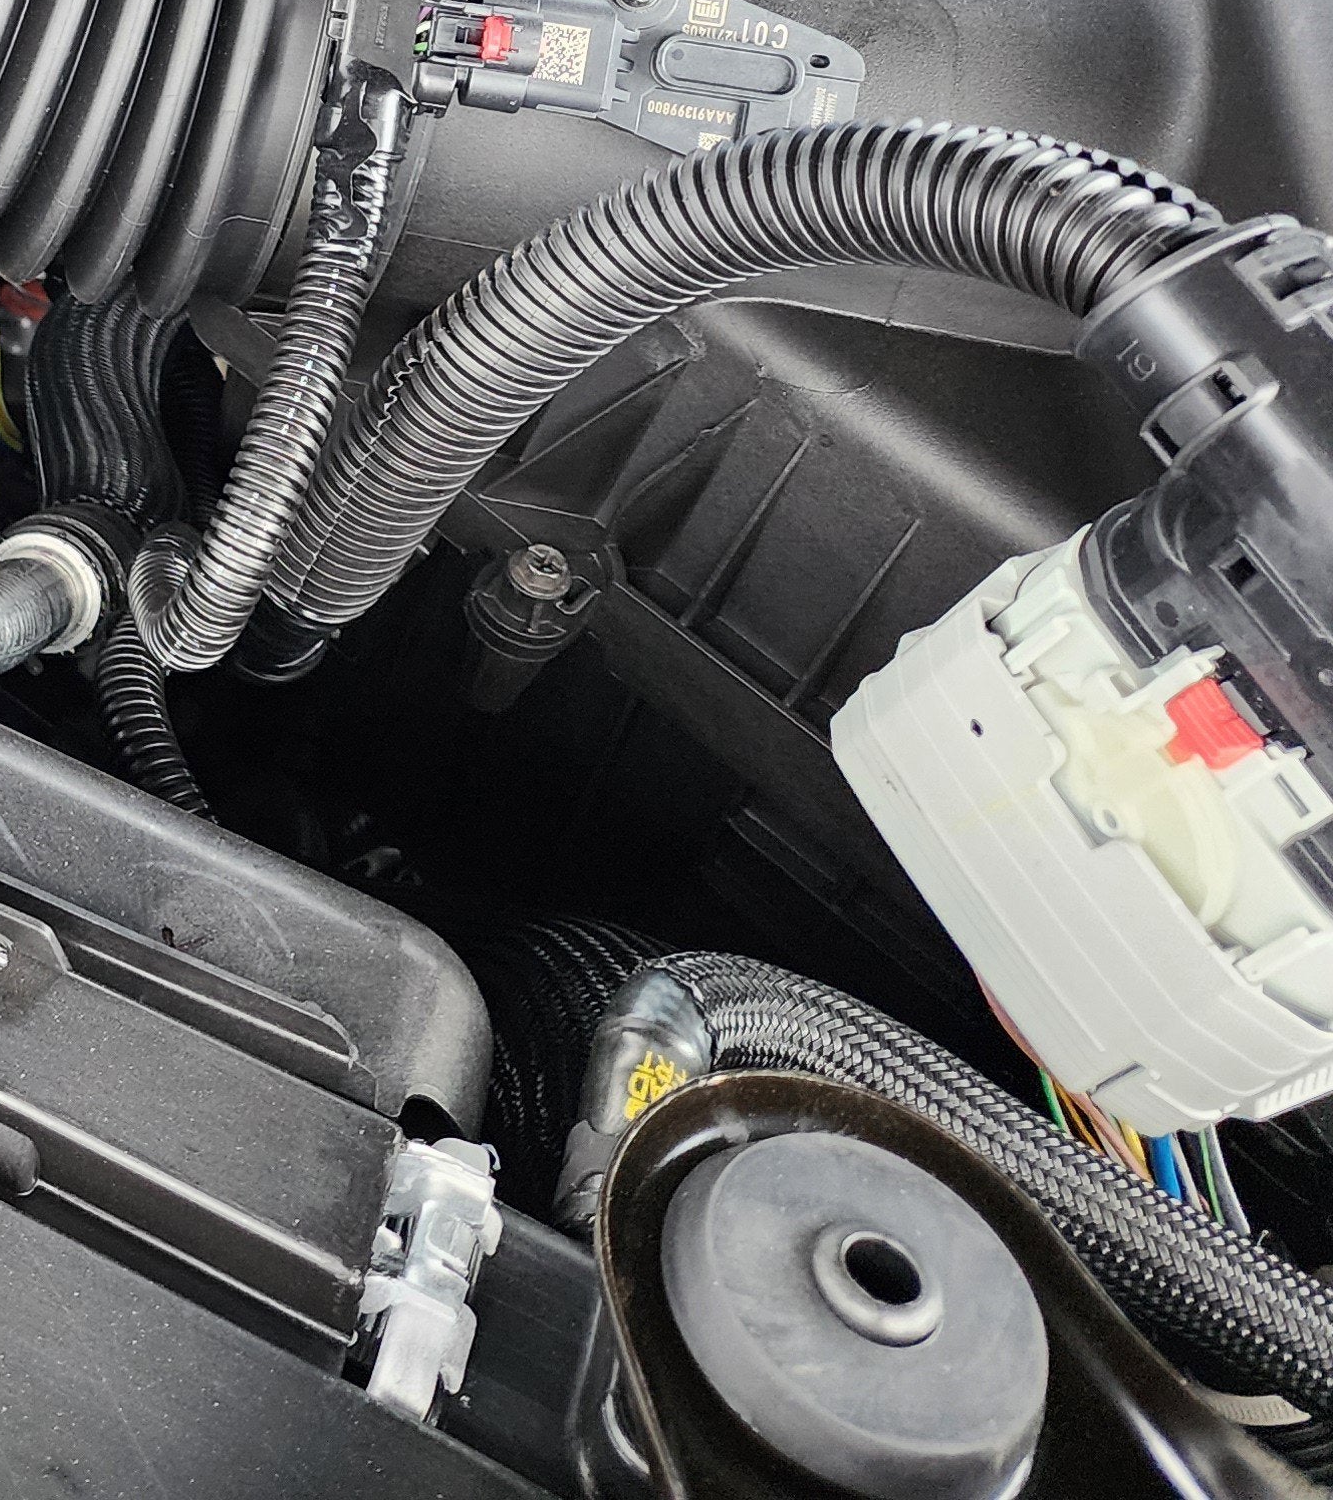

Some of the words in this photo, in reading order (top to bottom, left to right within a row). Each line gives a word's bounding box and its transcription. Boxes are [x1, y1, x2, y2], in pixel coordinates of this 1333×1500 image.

[694, 0, 721, 19] gm
[740, 18, 789, 49] C01
[647, 99, 737, 125] AAA91399800
